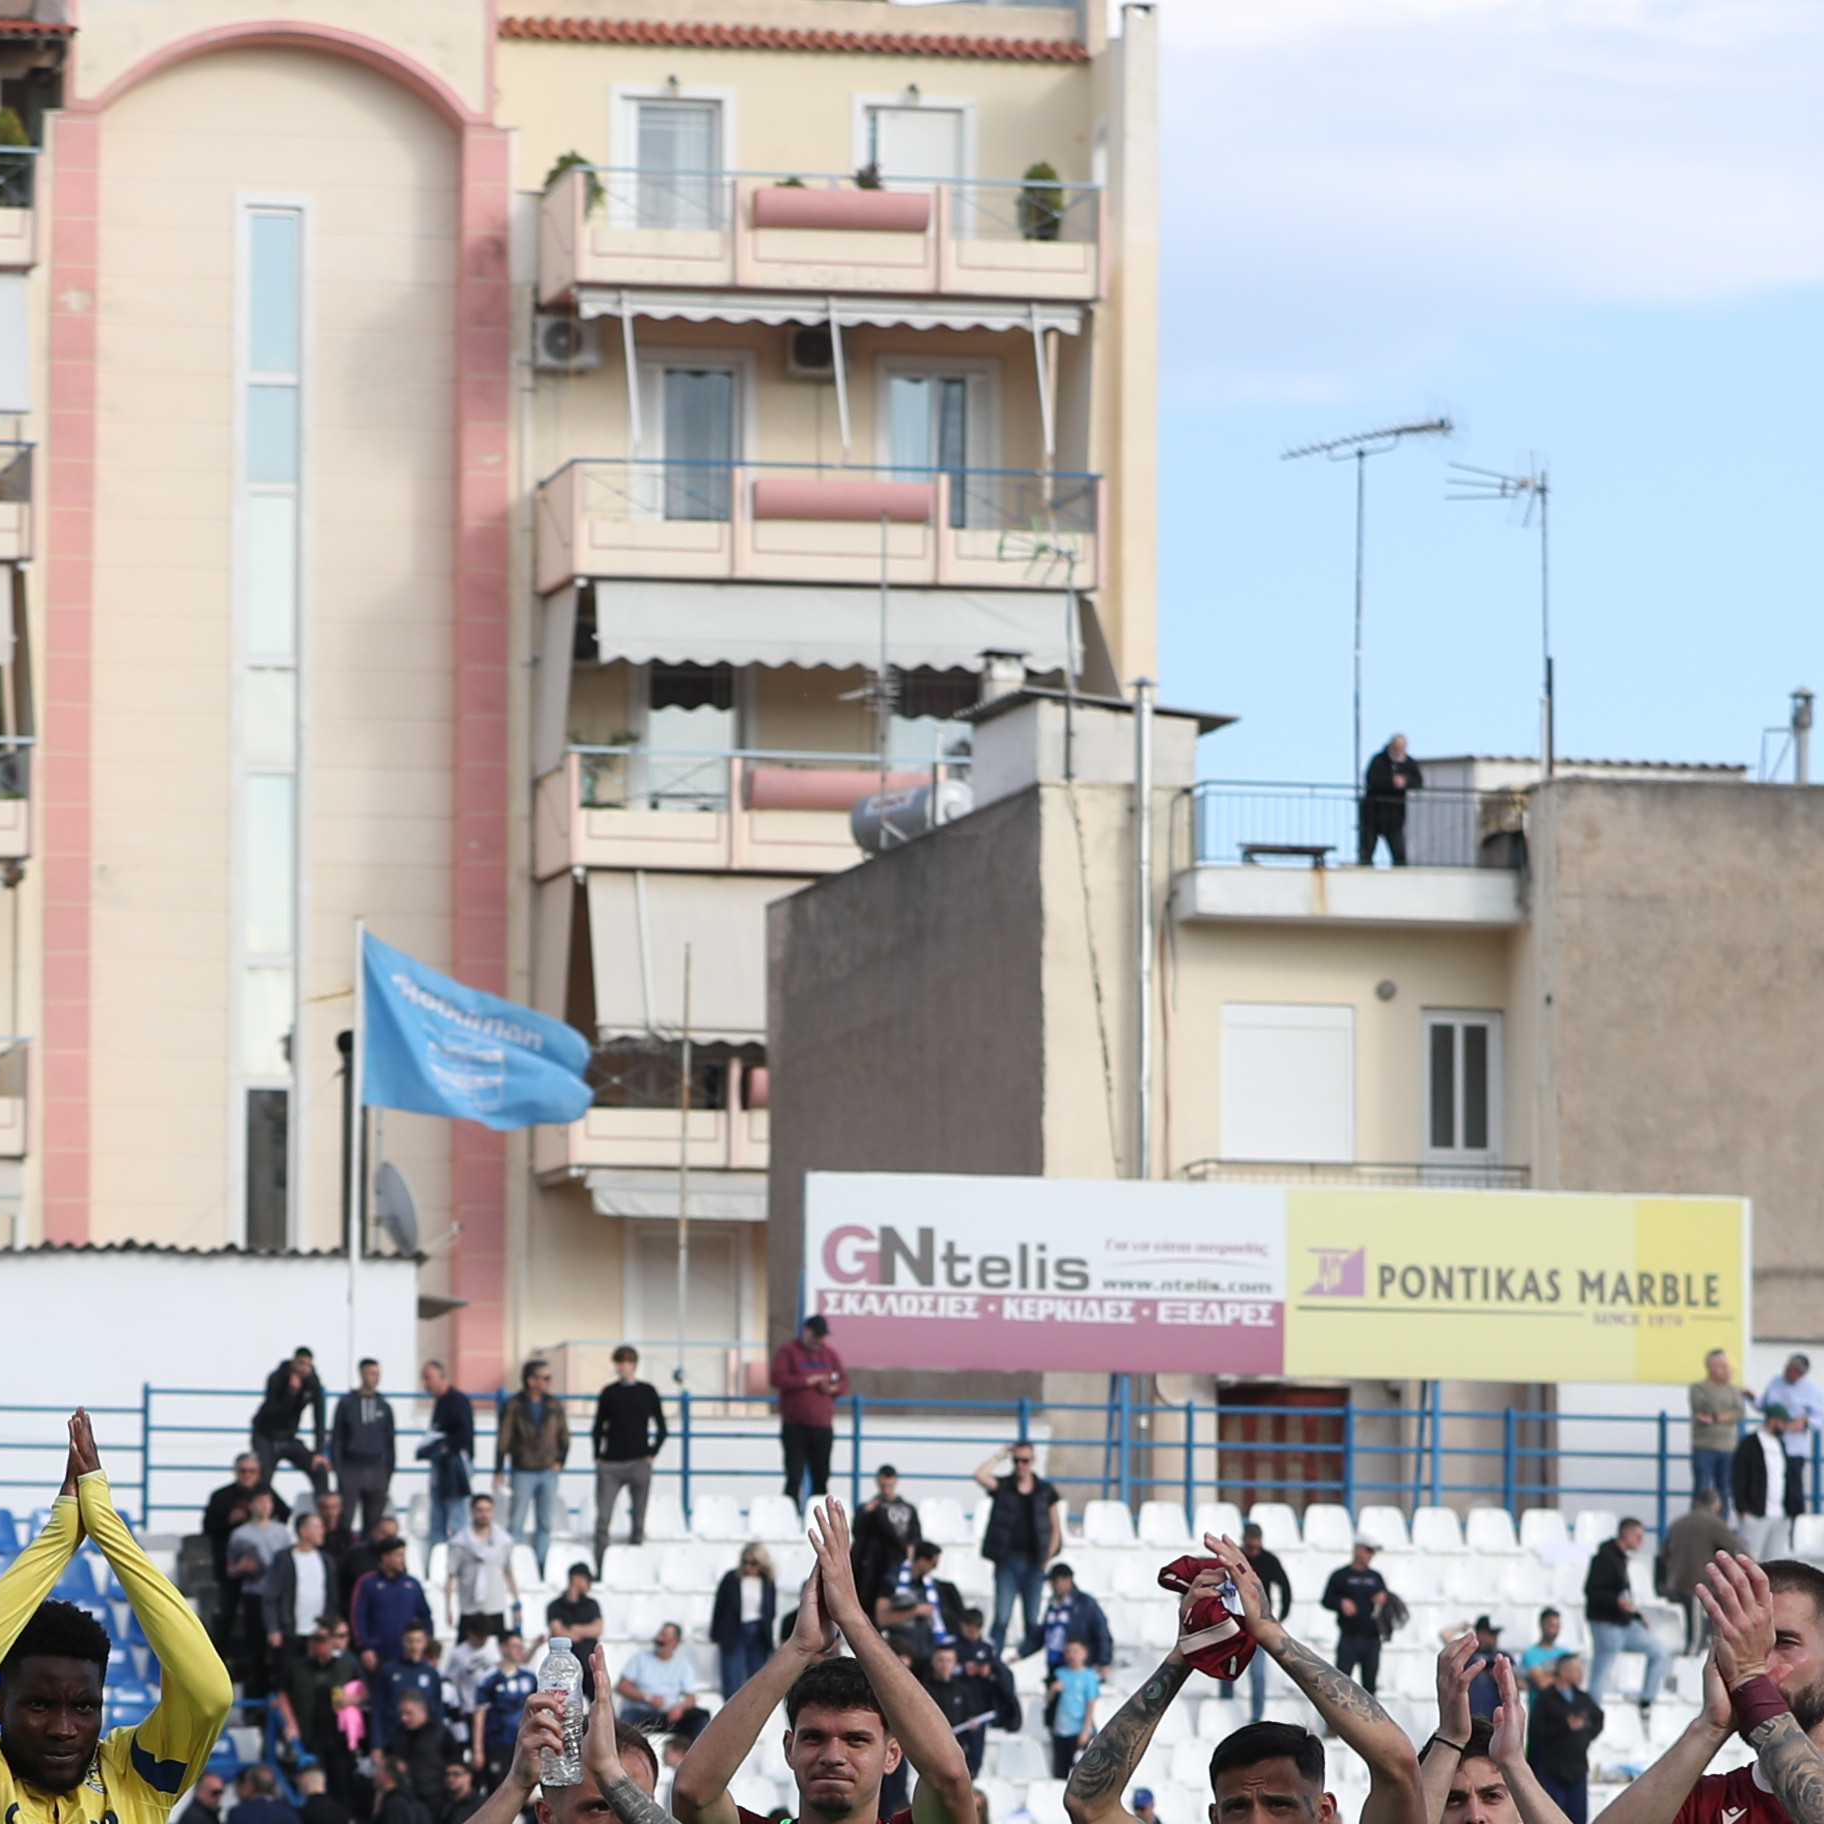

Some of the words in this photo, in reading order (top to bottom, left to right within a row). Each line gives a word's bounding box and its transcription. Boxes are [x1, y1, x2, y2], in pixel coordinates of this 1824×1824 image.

[822, 1224, 1090, 1291] GNtelis
[1102, 1277, 1273, 1295] www.ntelis.com
[1377, 1264, 1562, 1303] PONTIKAS
[1577, 1270, 1722, 1309] MARBLE
[824, 1292, 980, 1319] ΣΚΑΛΩΣΙΕΣ
[1002, 1297, 1136, 1324] ΚΕΡΚΙΔΕΣ
[1157, 1300, 1275, 1328] ΕΞΕΔΡΕΣ
